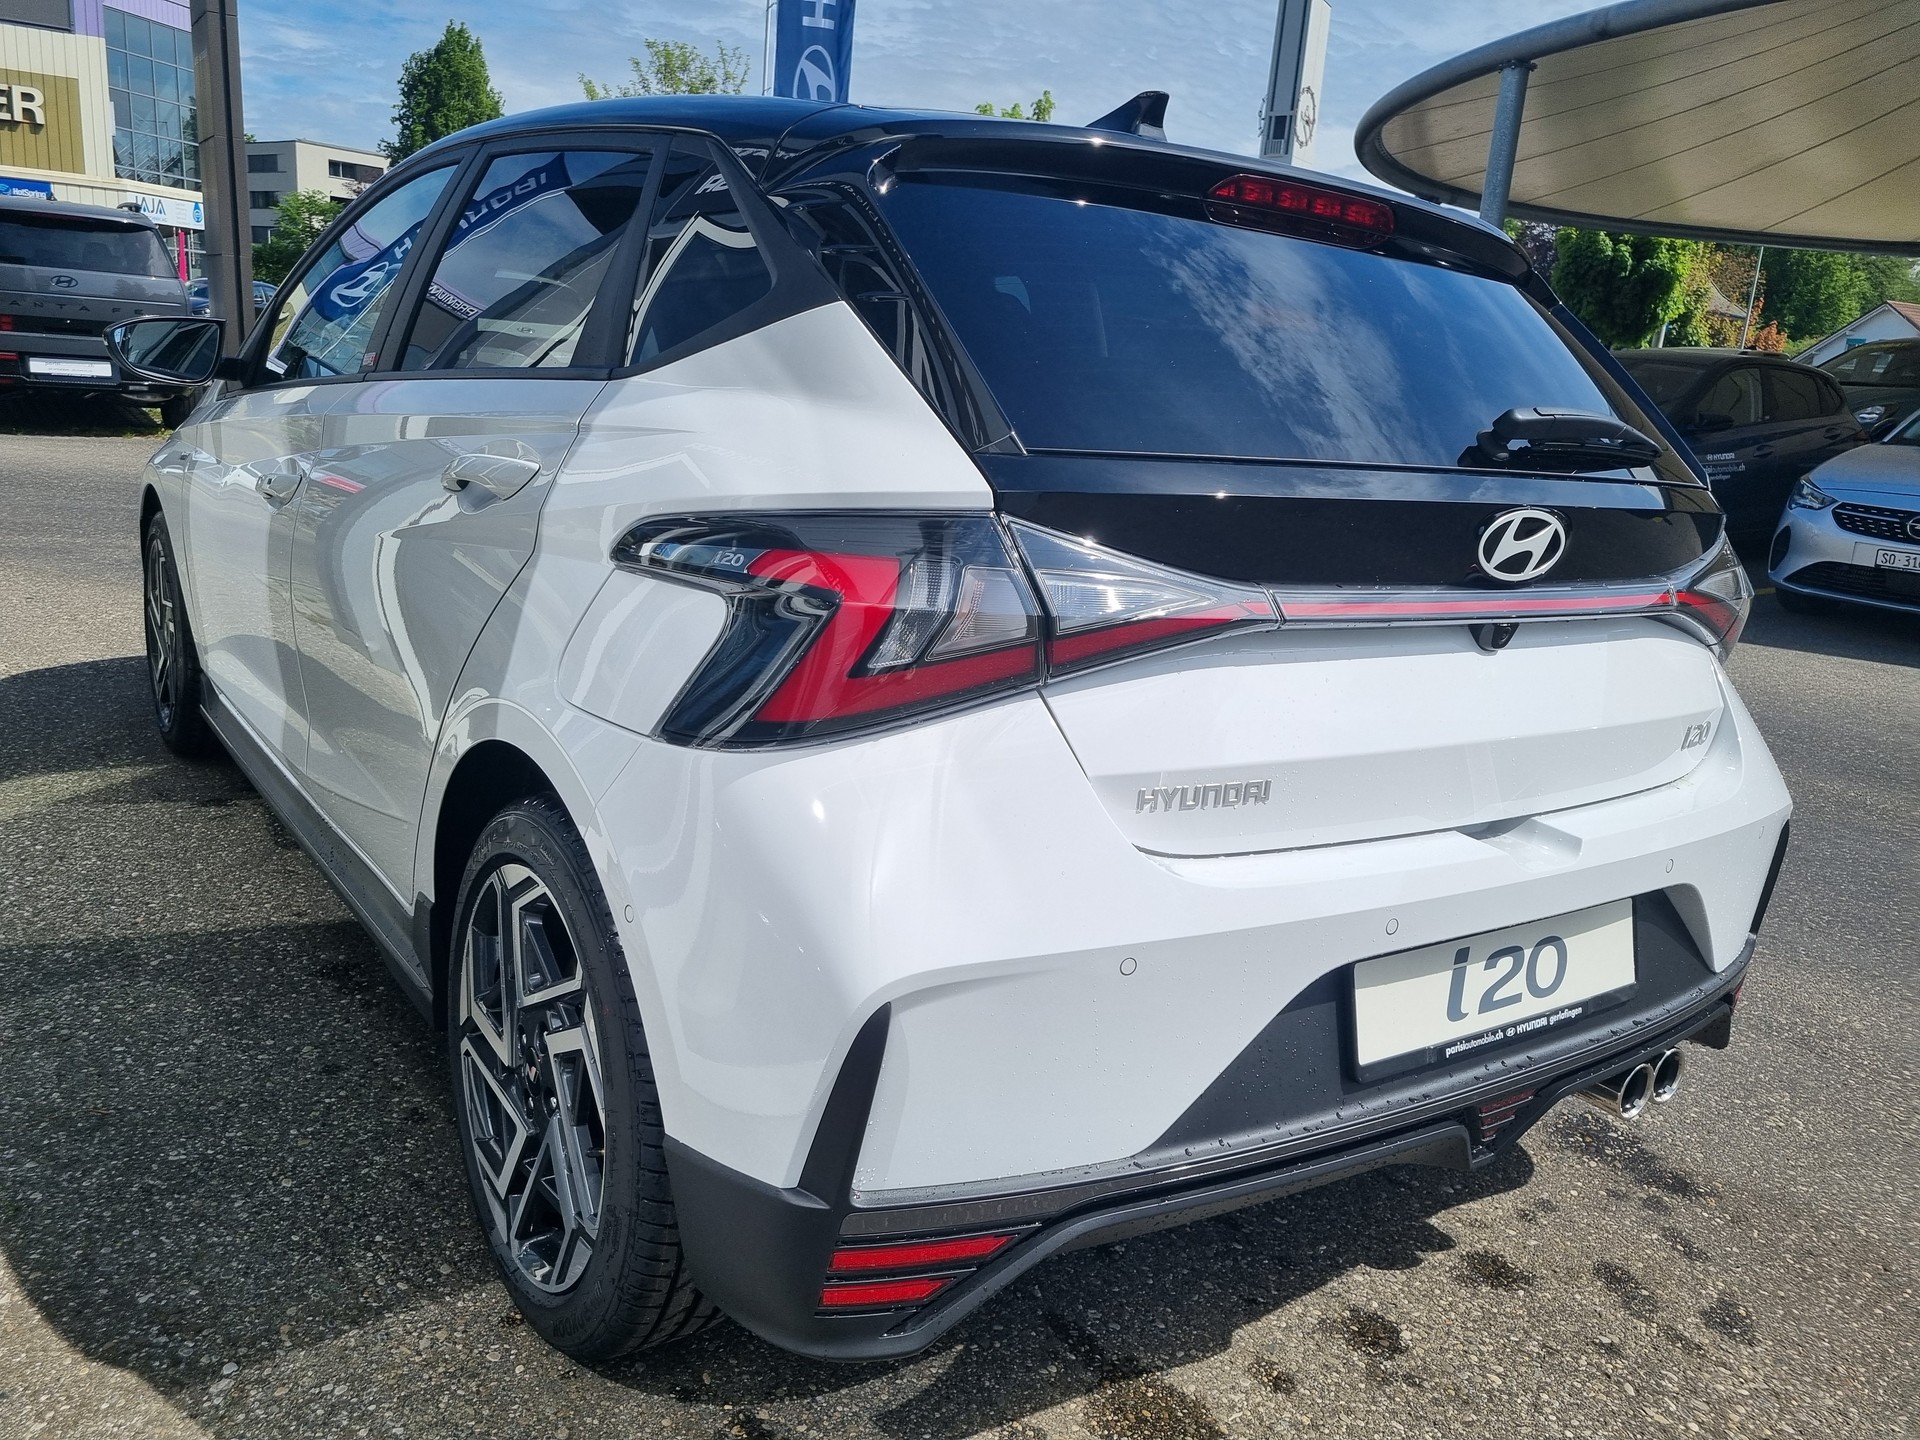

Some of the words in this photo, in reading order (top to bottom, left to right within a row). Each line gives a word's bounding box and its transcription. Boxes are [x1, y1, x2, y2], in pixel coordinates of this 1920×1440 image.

[1713, 452, 1735, 461] HYUNDAI
[713, 550, 745, 567] i20
[1680, 720, 1711, 751] i20
[1135, 778, 1273, 814] HYUNDAI
[1446, 935, 1568, 1023] i20
[1445, 1028, 1504, 1058] parisiautomobile.ch
[1516, 1016, 1548, 1035] HYUNDAI
[1549, 1006, 1583, 1026] gerlafingen
